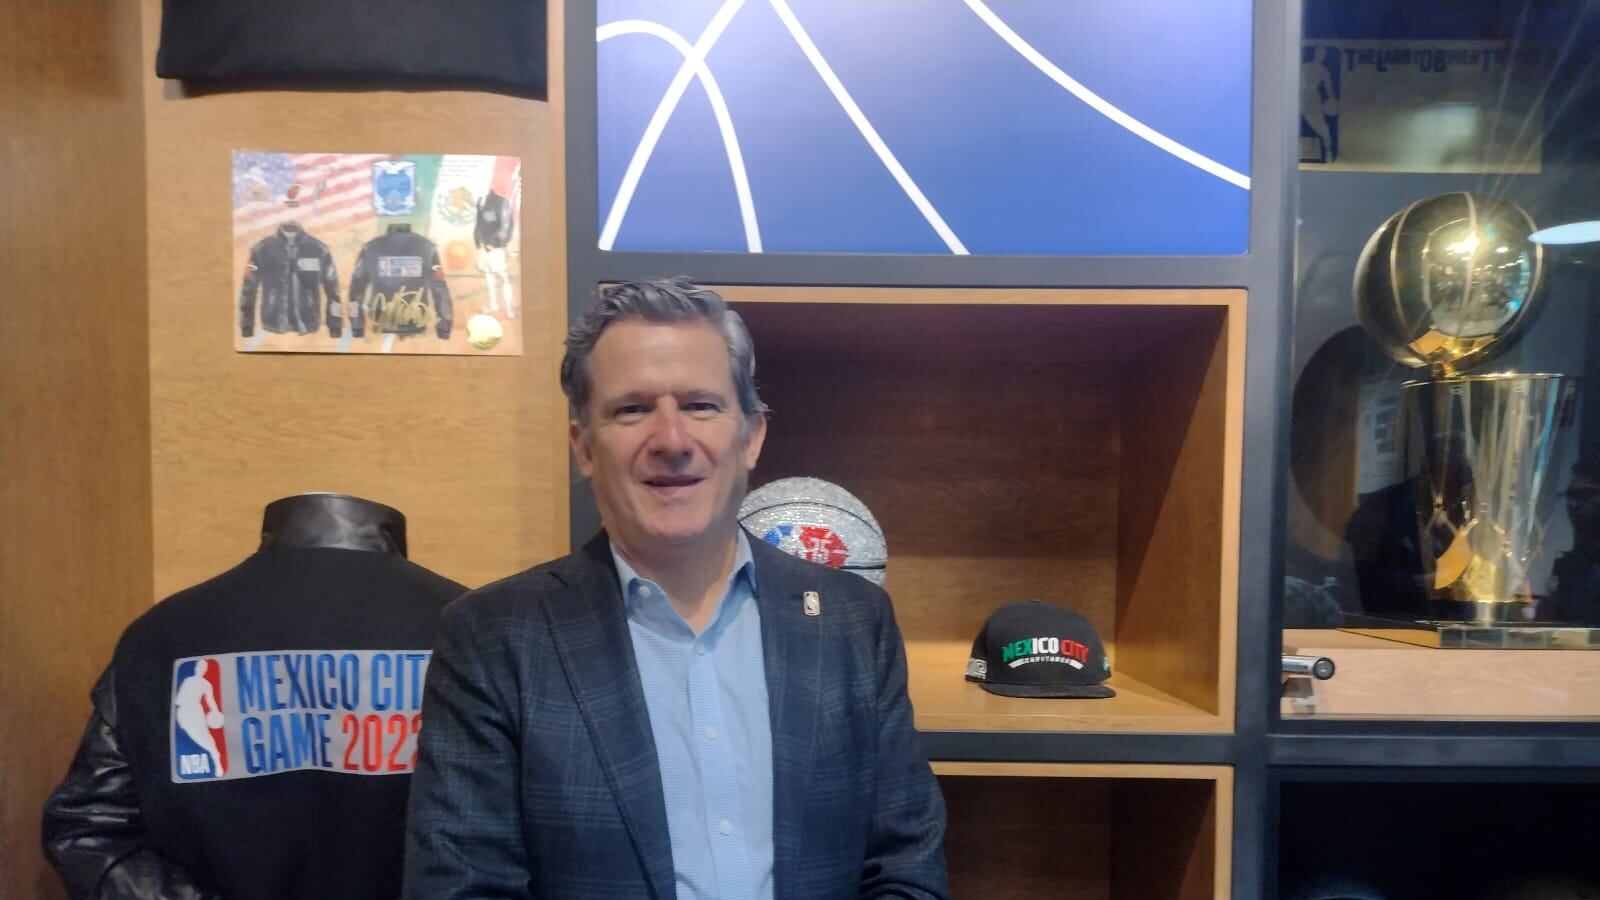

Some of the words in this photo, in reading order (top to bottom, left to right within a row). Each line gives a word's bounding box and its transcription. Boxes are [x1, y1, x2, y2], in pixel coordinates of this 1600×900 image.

[1001, 637, 1060, 663] MEXICO
[1060, 639, 1089, 664] CITY
[236, 653, 359, 713] MEXICO
[371, 653, 431, 711] CIT
[181, 753, 211, 775] NBA
[242, 713, 333, 773] GAME
